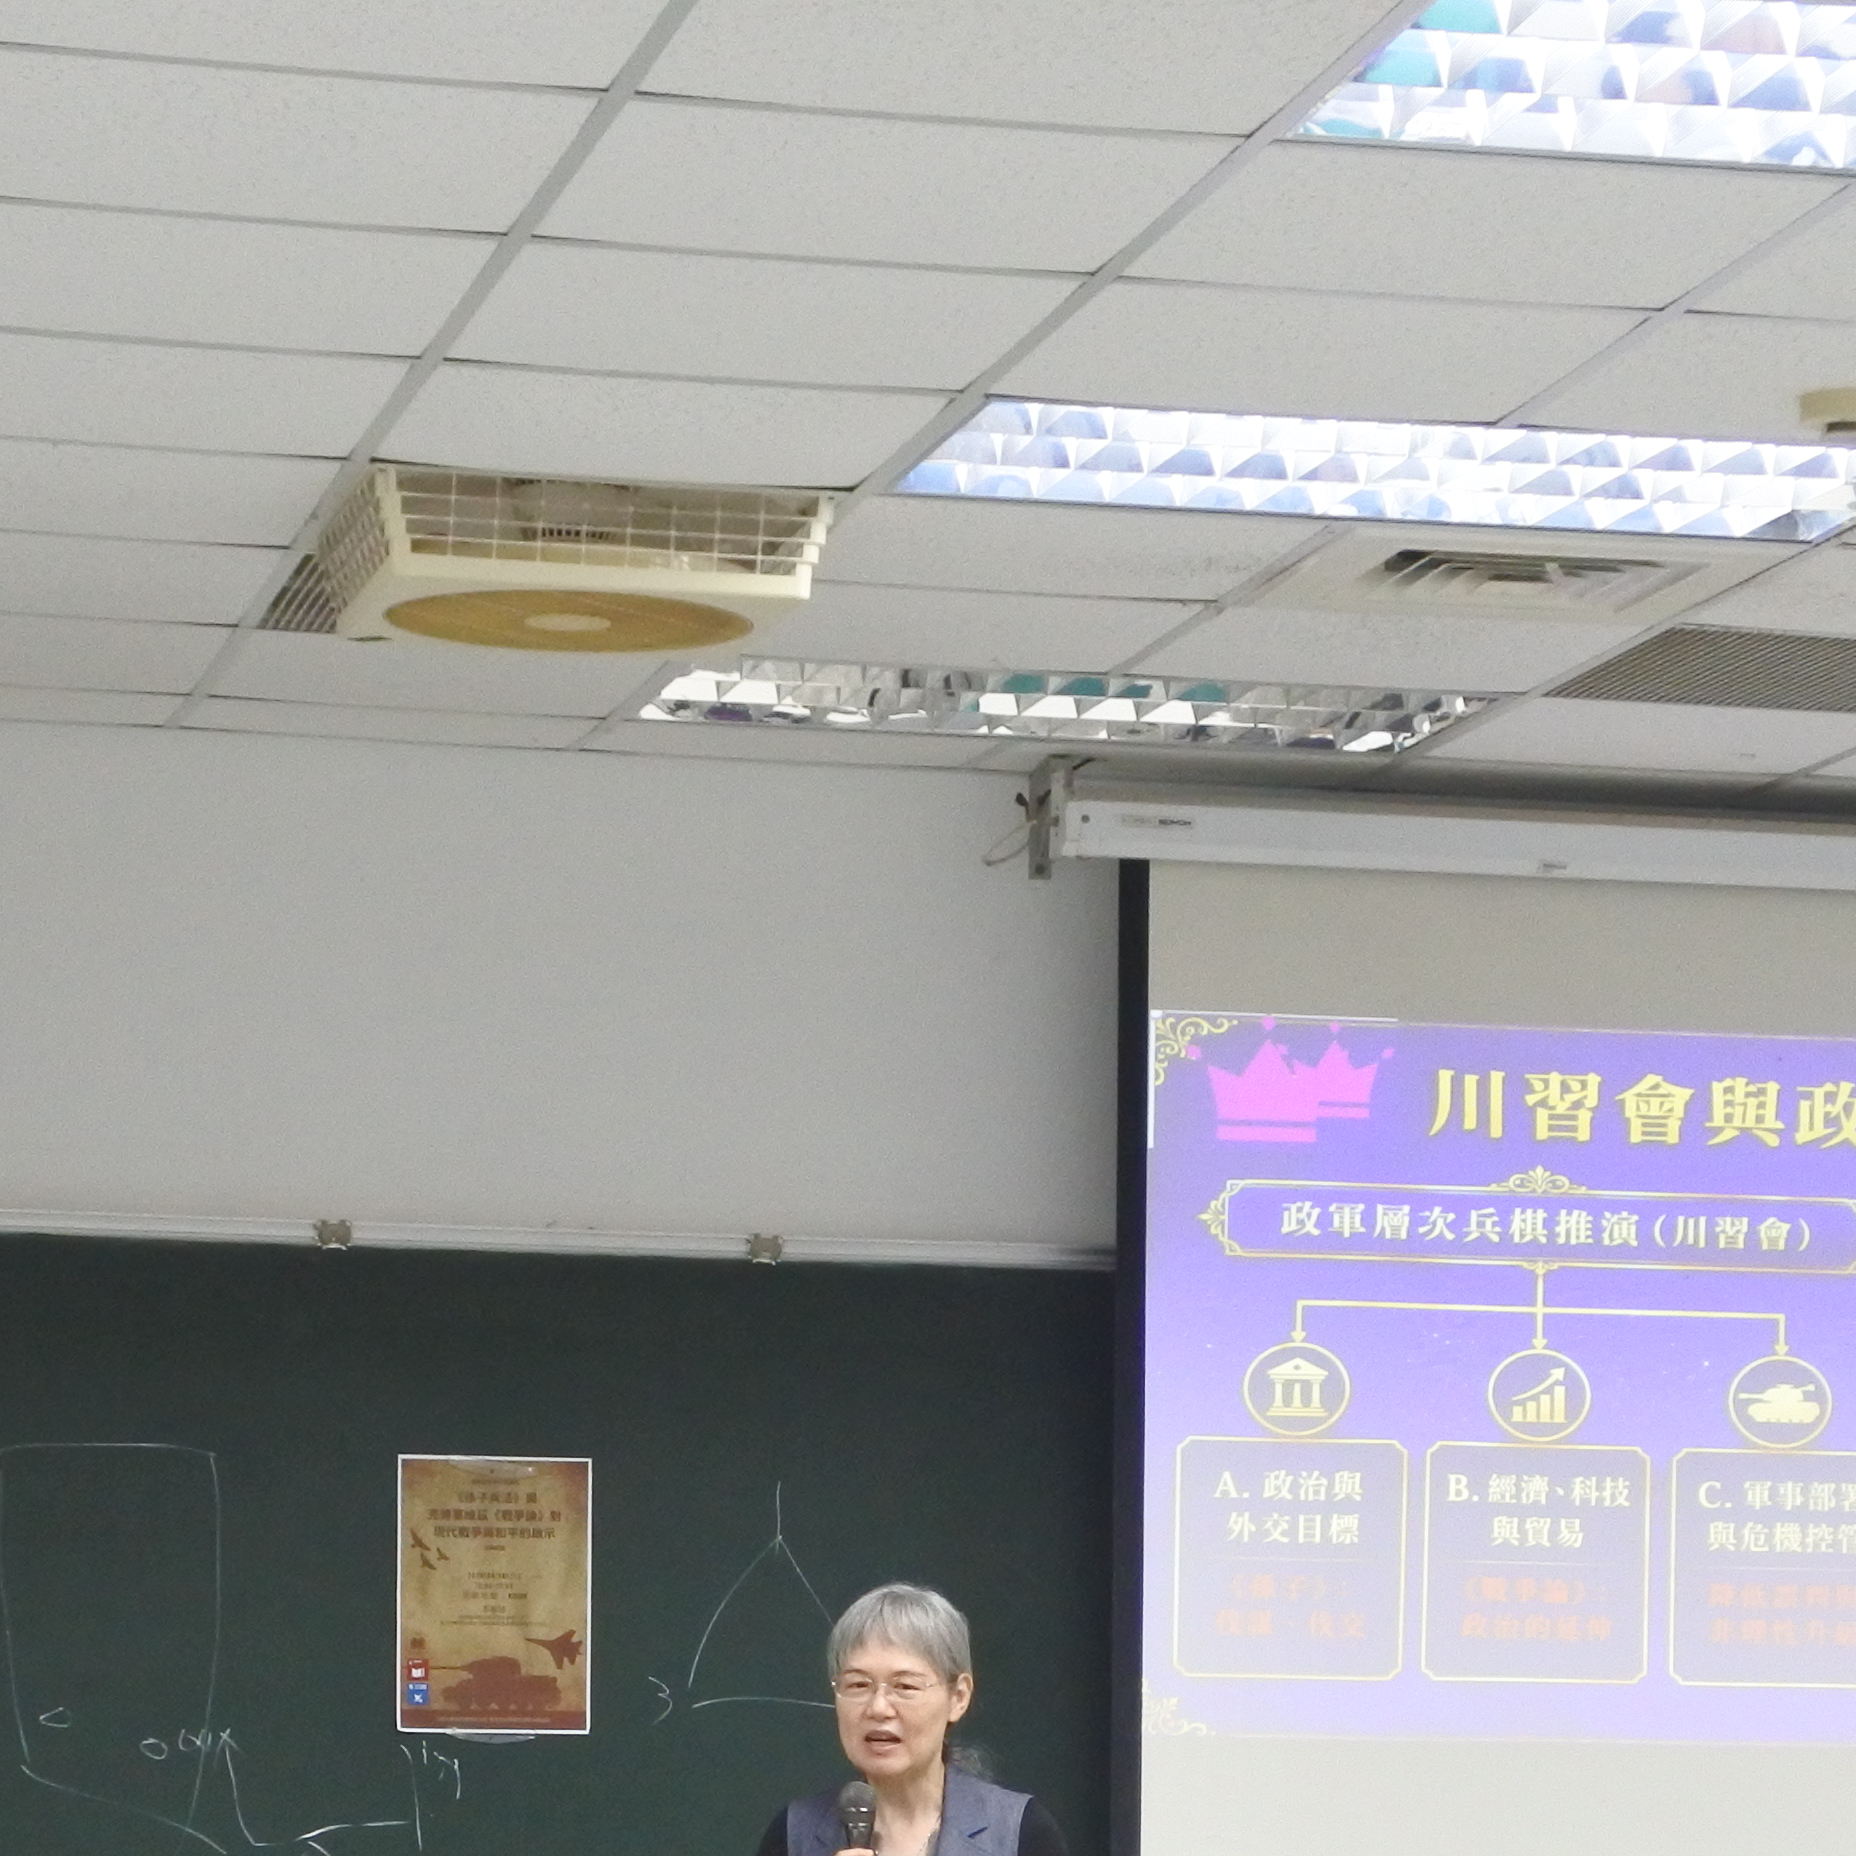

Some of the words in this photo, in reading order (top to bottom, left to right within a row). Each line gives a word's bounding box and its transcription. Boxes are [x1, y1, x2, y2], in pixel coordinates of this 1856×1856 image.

[1280, 1200, 1812, 1252] 政軍層次兵棋推演（川習會）
[1262, 1470, 1364, 1502] 政治與
[1487, 1473, 1631, 1507] 經濟、科技
[1226, 1510, 1361, 1545] 外交目標
[1490, 1515, 1585, 1549] 與貿易
